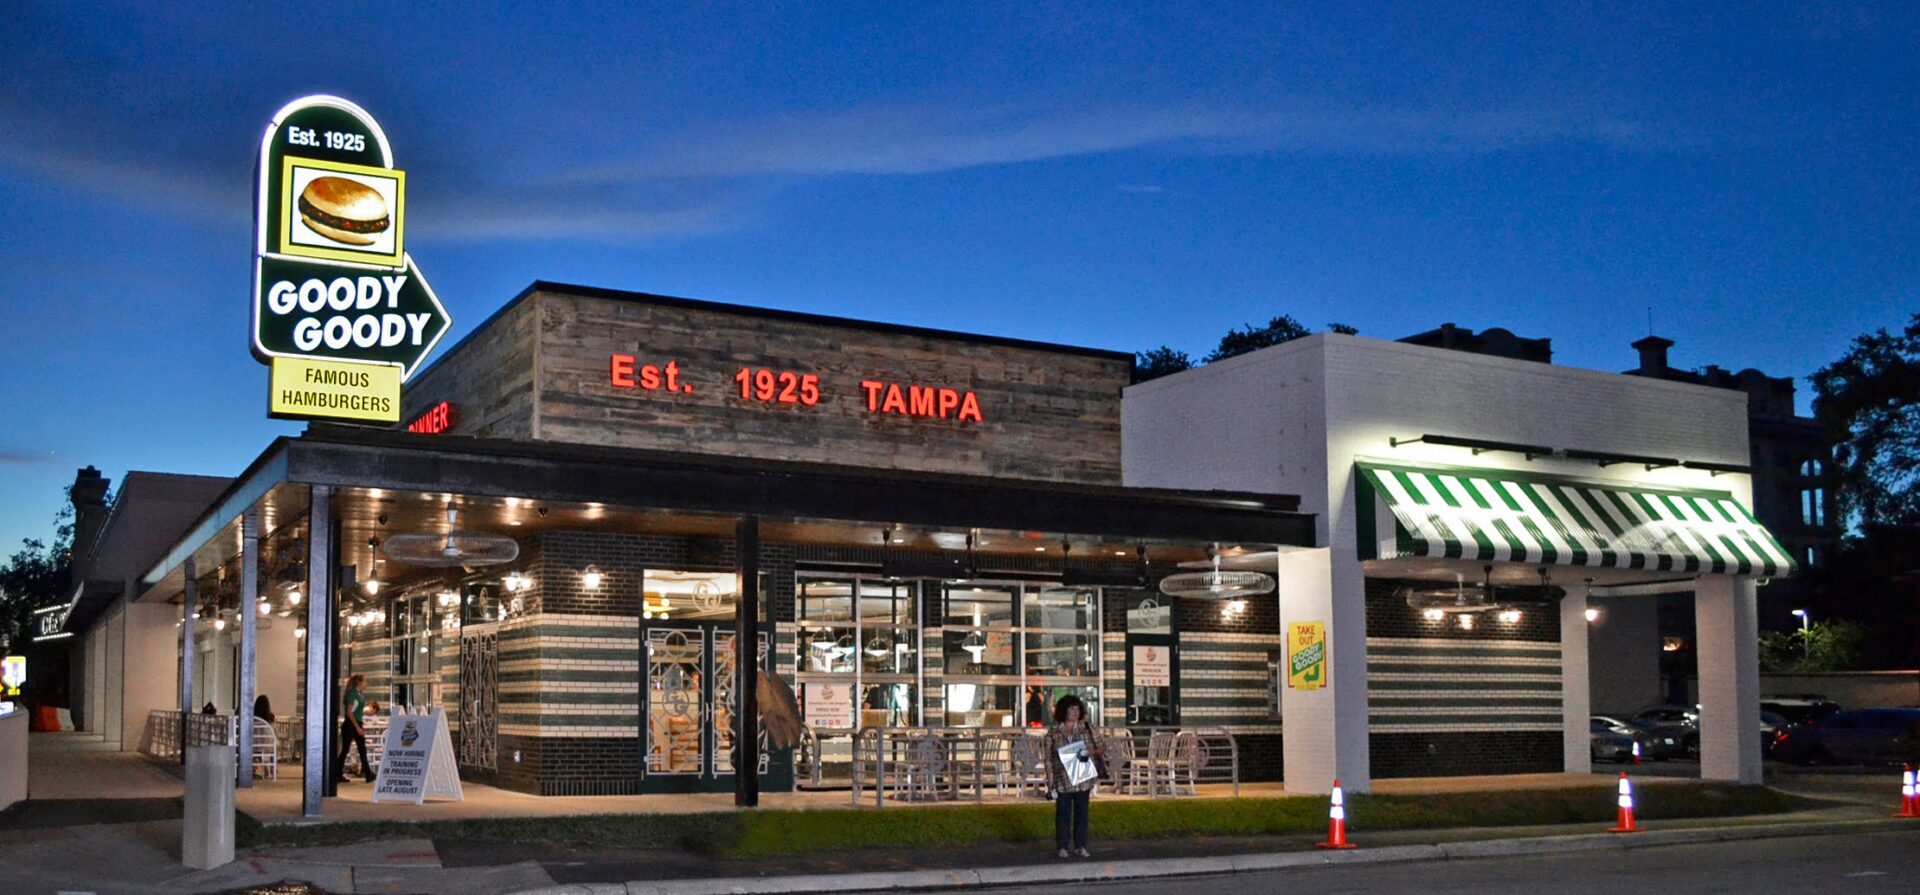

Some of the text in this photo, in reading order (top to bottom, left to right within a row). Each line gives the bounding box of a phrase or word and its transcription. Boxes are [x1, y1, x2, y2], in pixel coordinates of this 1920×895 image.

[288, 126, 365, 152] Est. 1925
[268, 275, 407, 315] GOODY
[293, 312, 431, 352] GOODY
[305, 367, 370, 388] FAMOUS
[610, 353, 983, 422] Est. 1925 TAMPA
[282, 389, 391, 413] HAMBURGERS
[1296, 625, 1316, 635] TAKE
[1298, 636, 1314, 645] OUT
[1293, 643, 1320, 663] GOODY
[1295, 650, 1323, 670] GOODY
[394, 786, 418, 794] AUGUST
